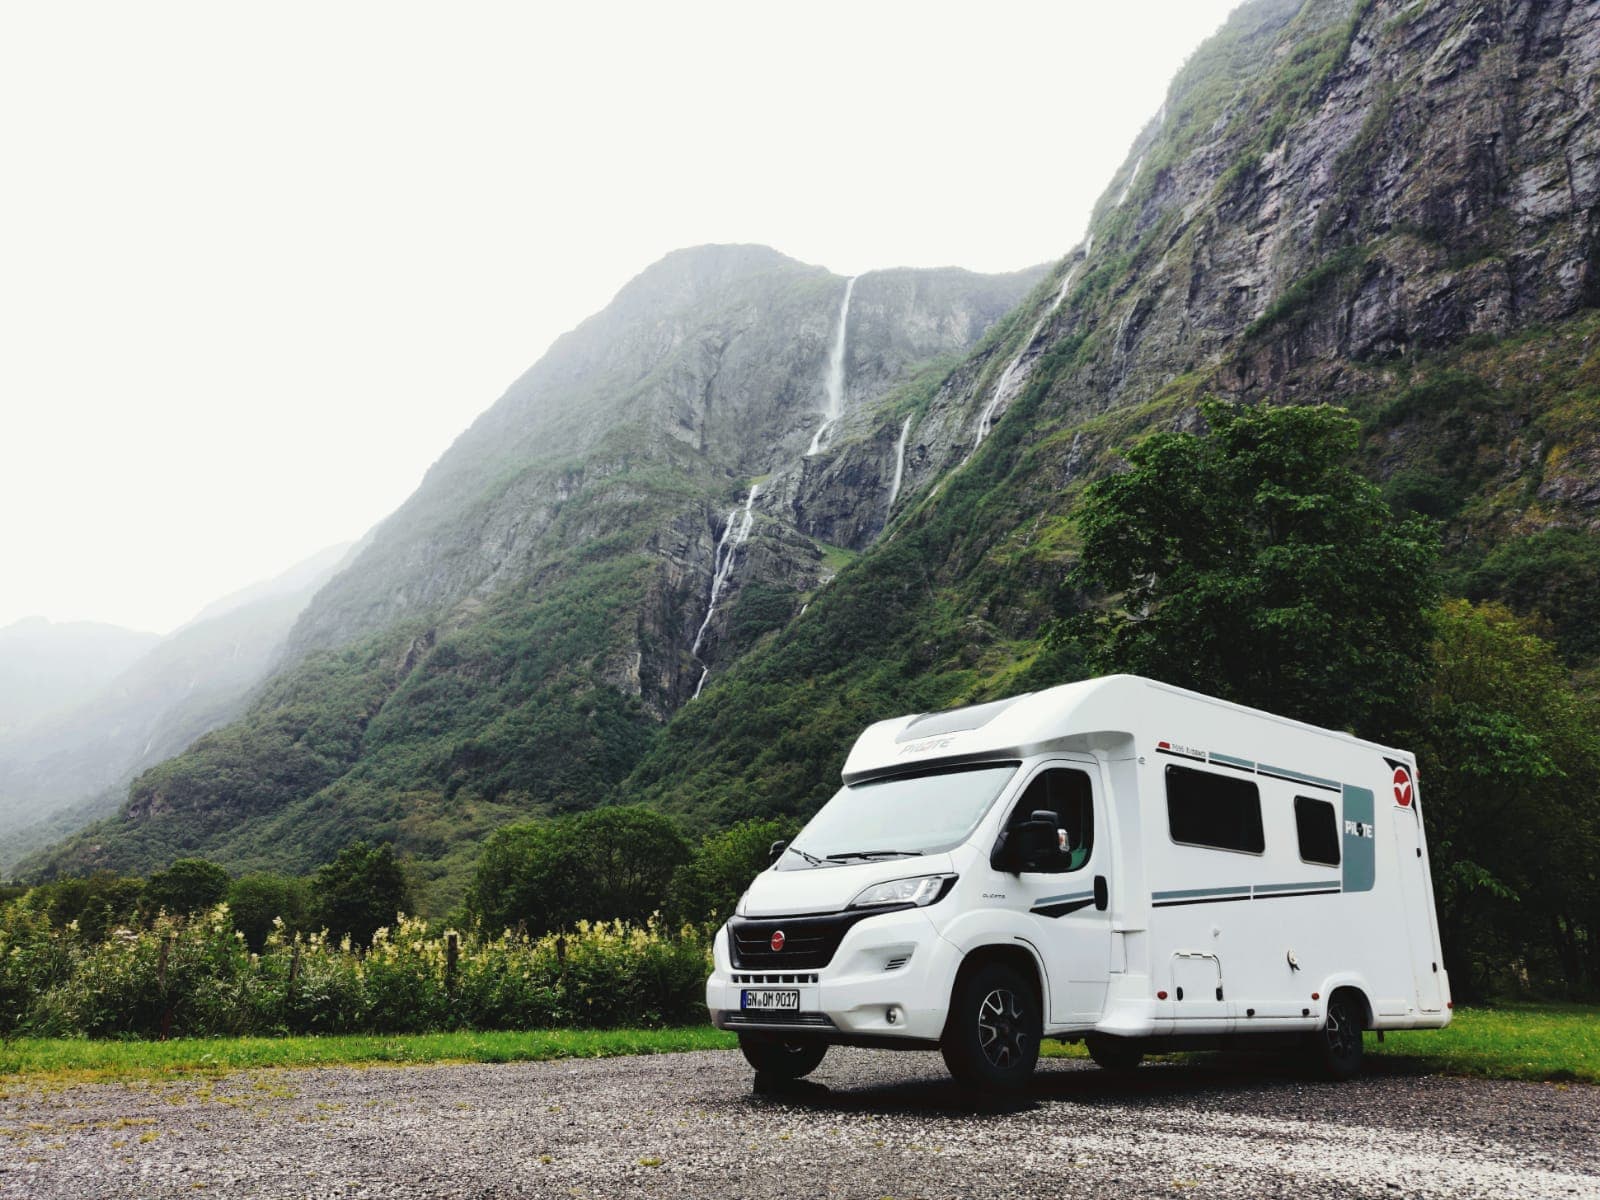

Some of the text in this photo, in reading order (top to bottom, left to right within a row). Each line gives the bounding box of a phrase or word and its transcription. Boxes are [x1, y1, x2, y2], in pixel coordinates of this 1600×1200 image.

[747, 992, 797, 1007] GN OM 9017
